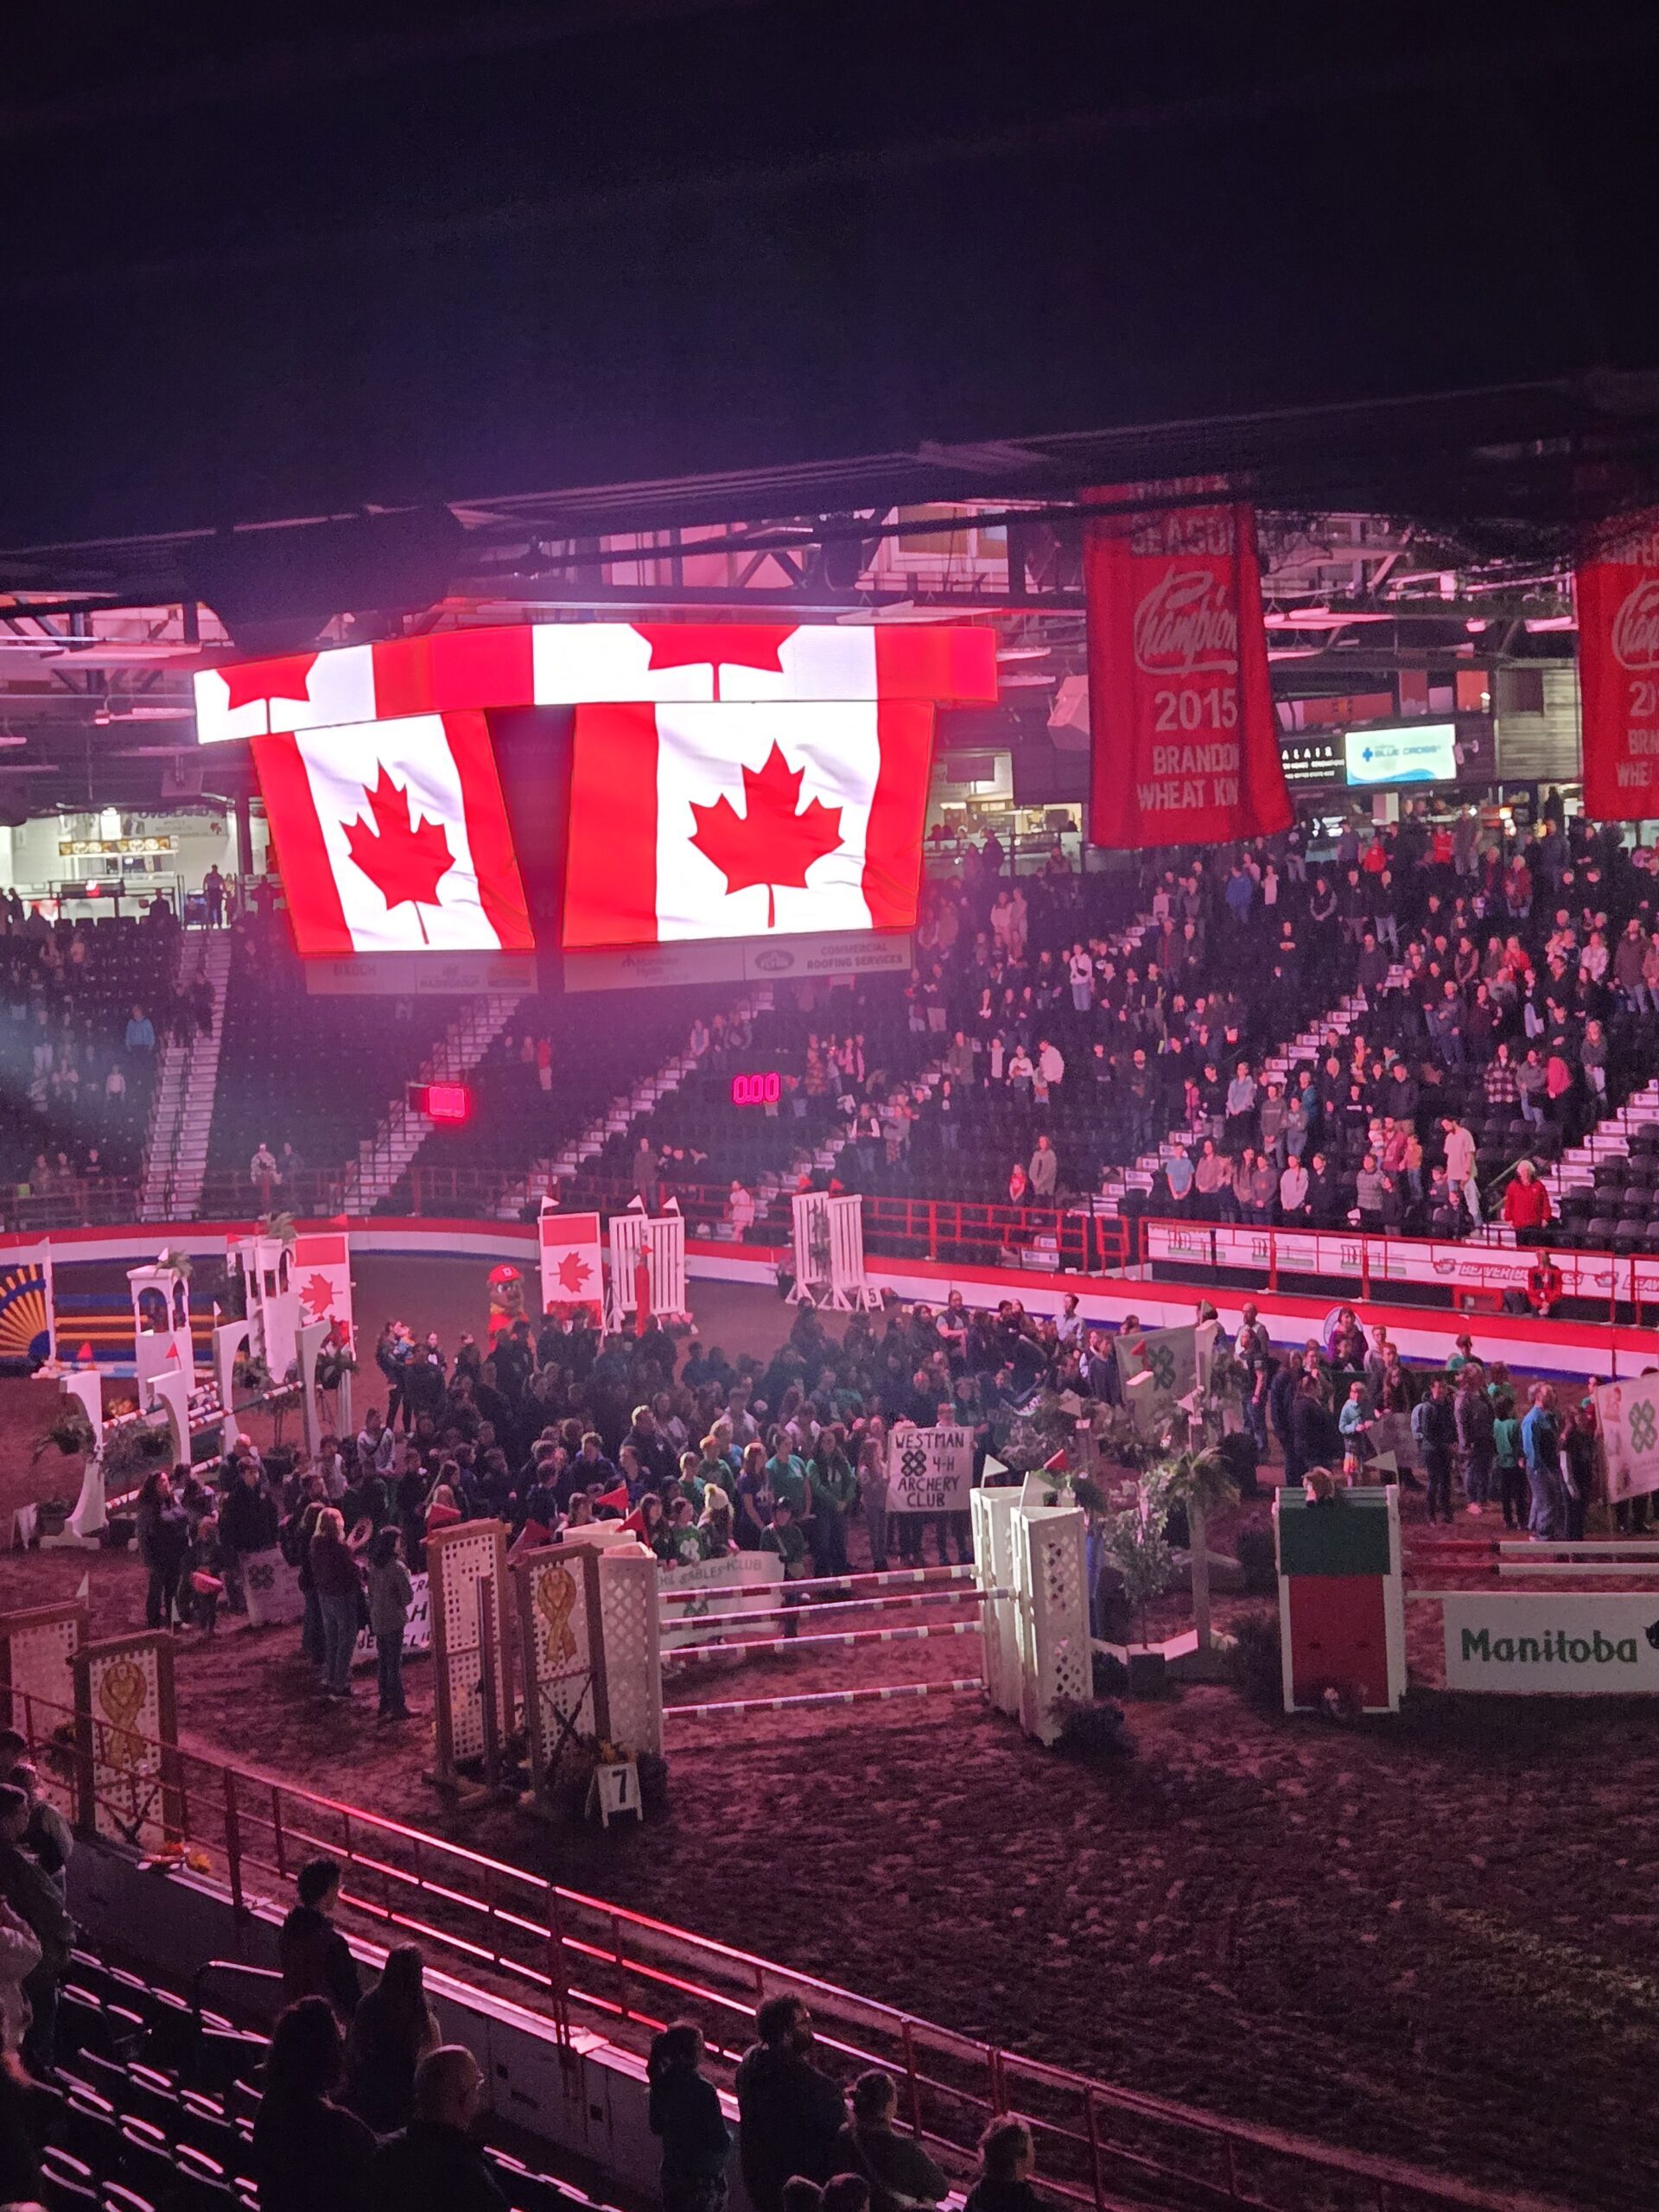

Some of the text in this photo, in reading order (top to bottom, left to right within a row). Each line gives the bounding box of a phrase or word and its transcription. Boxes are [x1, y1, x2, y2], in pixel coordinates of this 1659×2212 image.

[1154, 688, 1238, 732] 2015
[1137, 779, 1206, 811] WHEAT
[807, 957, 853, 969] ROOFING
[855, 954, 904, 967] SERVICES
[868, 1287, 877, 1303] 5
[895, 1433, 964, 1449] WESTMAN
[933, 1456, 955, 1472] 4-H
[897, 1475, 961, 1491] ARCHERY
[906, 1492, 945, 1507] CLUB
[1461, 1628, 1638, 1664] Manitoba
[611, 1768, 627, 1804] 7
